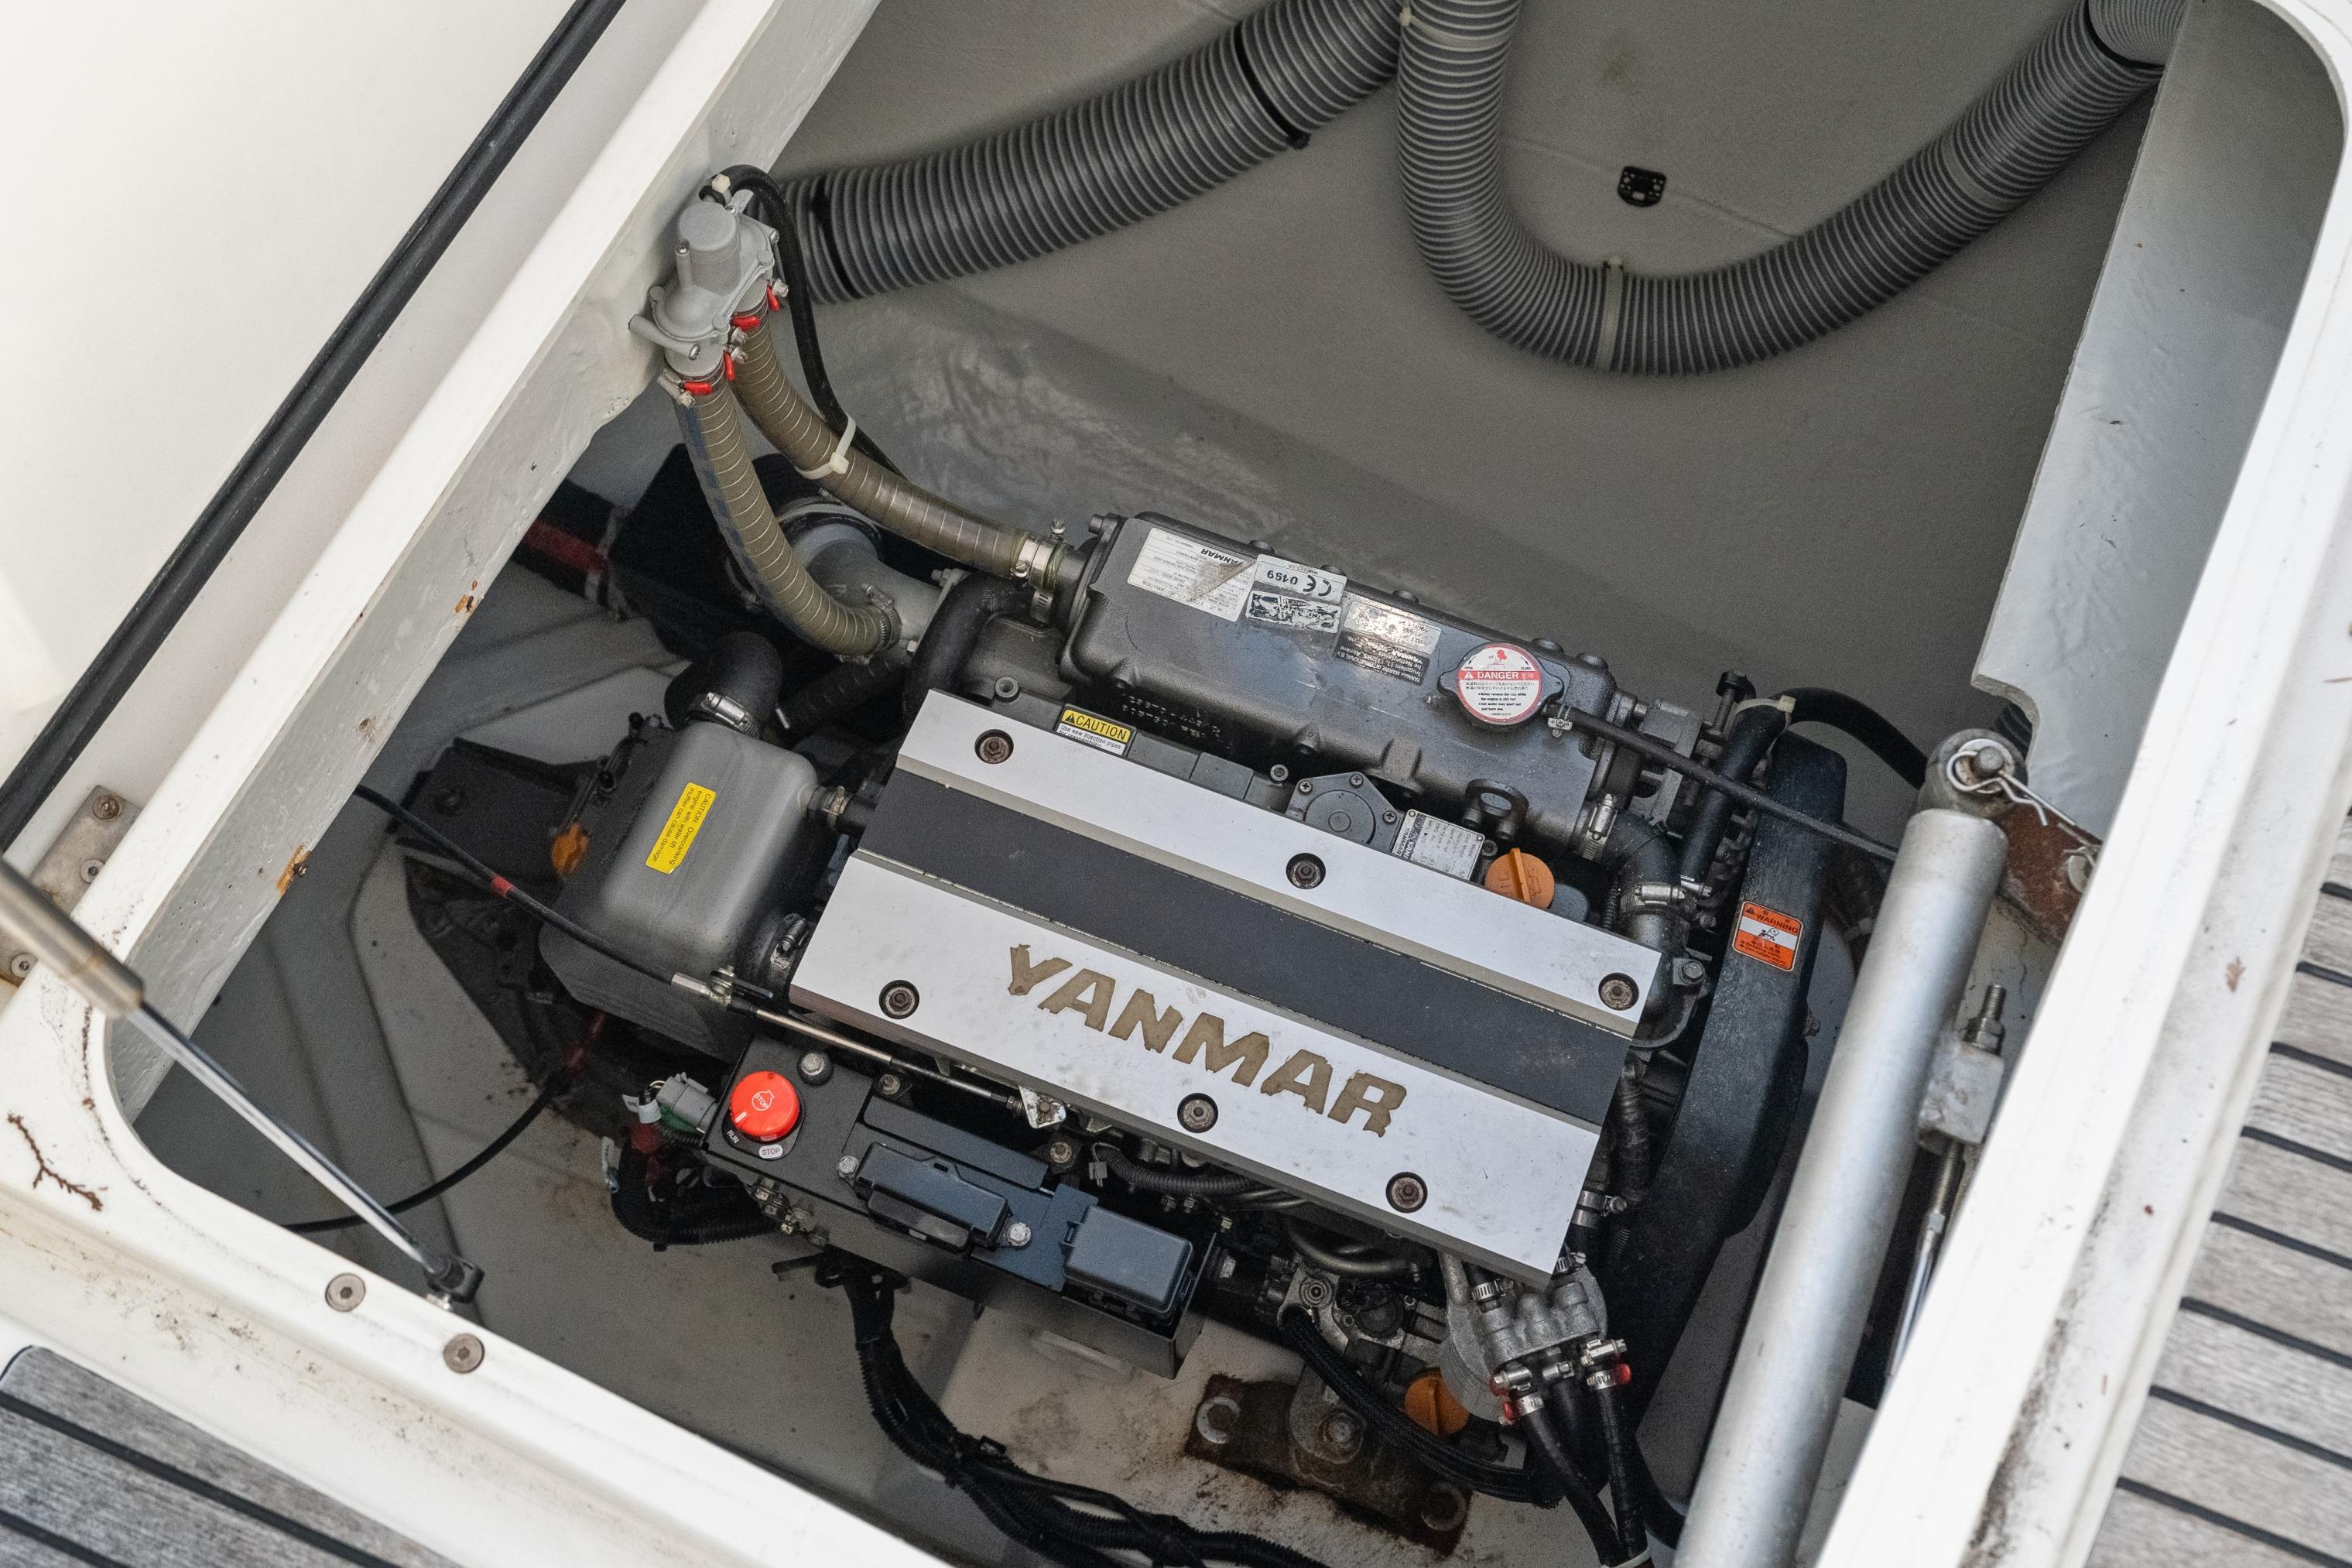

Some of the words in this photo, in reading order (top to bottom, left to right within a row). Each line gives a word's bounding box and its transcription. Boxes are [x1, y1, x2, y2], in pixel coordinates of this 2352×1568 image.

[1060, 724, 1071, 733] Use
[1083, 732, 1106, 745] injection
[1106, 740, 1121, 750] pipes
[1075, 714, 1127, 741] CAUTION
[688, 789, 703, 810] engine
[691, 792, 711, 823] CAUTION
[674, 806, 684, 820] can
[682, 810, 692, 823] with
[664, 818, 678, 838] cause
[673, 823, 685, 840] water
[668, 840, 677, 848] lift
[668, 825, 694, 866] Overcranking
[1395, 827, 1410, 855] YANMAR
[1402, 840, 1414, 859] YAN
[1755, 912, 1799, 934] WARNING
[1008, 943, 1408, 1138] YANMAR
[753, 1093, 769, 1109] STOP
[725, 1129, 741, 1144] RUN
